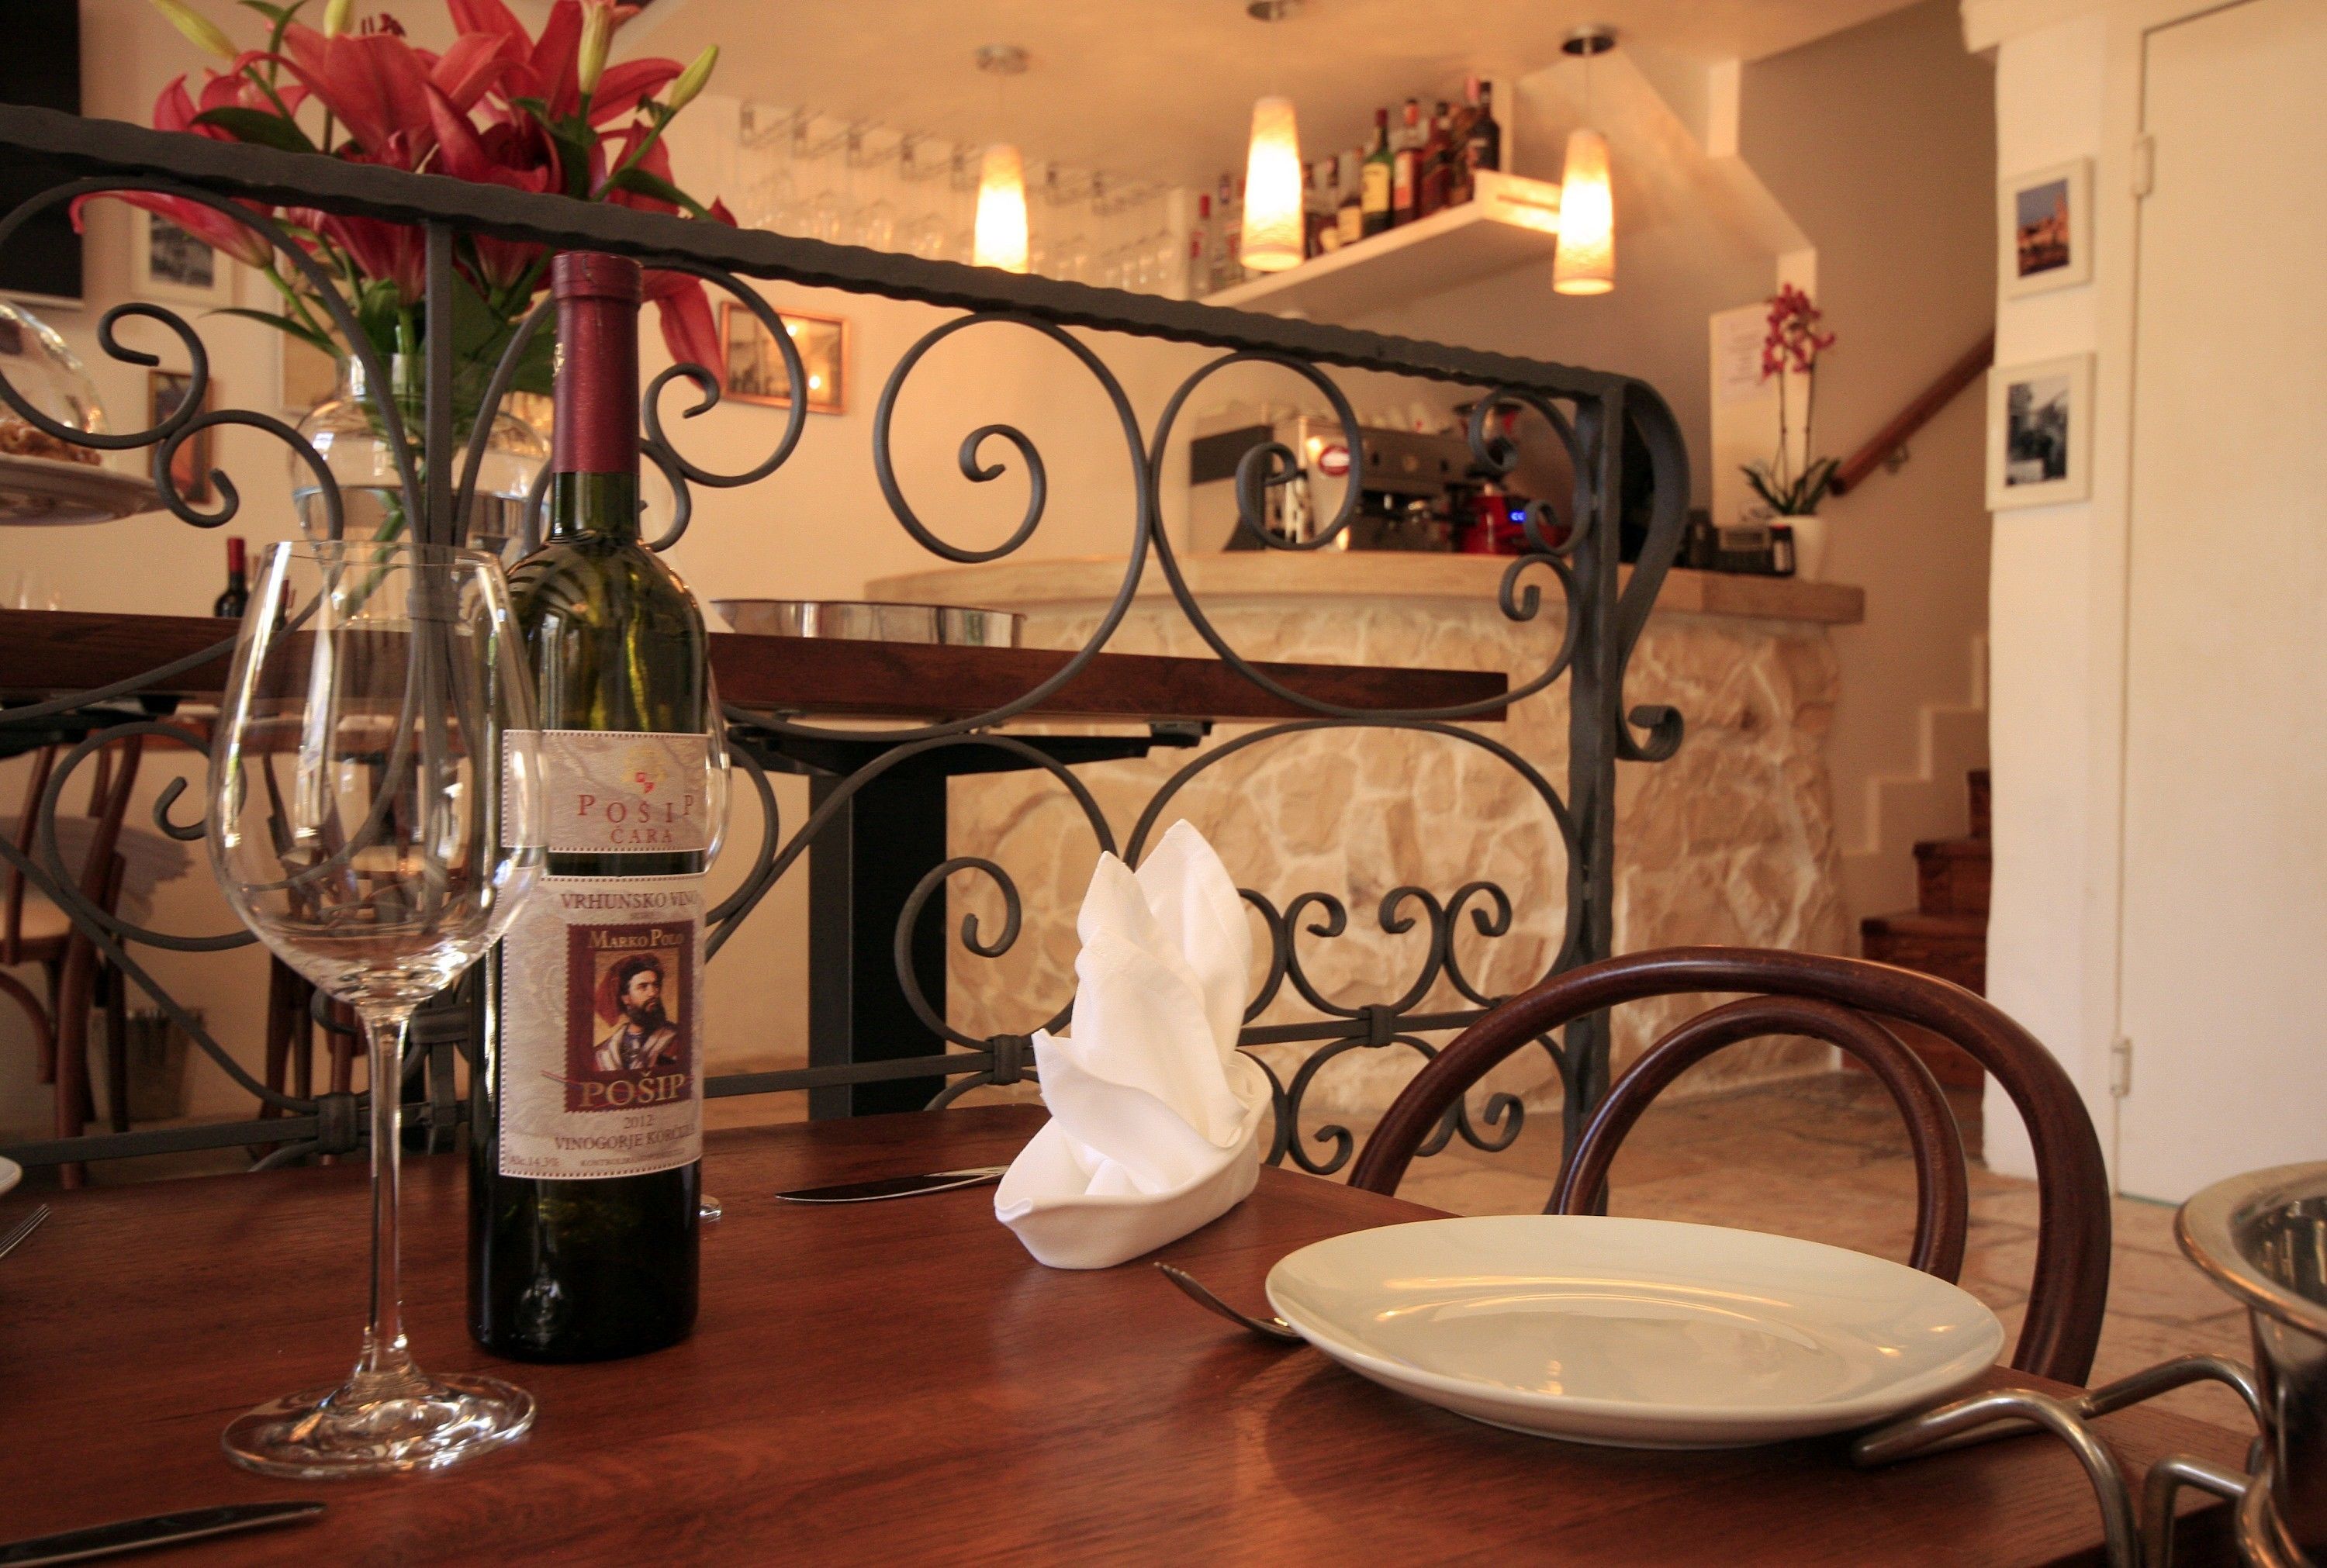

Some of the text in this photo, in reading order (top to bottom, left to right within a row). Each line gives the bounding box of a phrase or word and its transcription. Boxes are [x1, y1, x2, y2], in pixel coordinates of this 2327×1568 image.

[560, 893, 666, 910] VRHUNSKO
[577, 1071, 686, 1107] POŠIP
[623, 1114, 655, 1129] 2012
[554, 1133, 644, 1151] VINOGORJE
